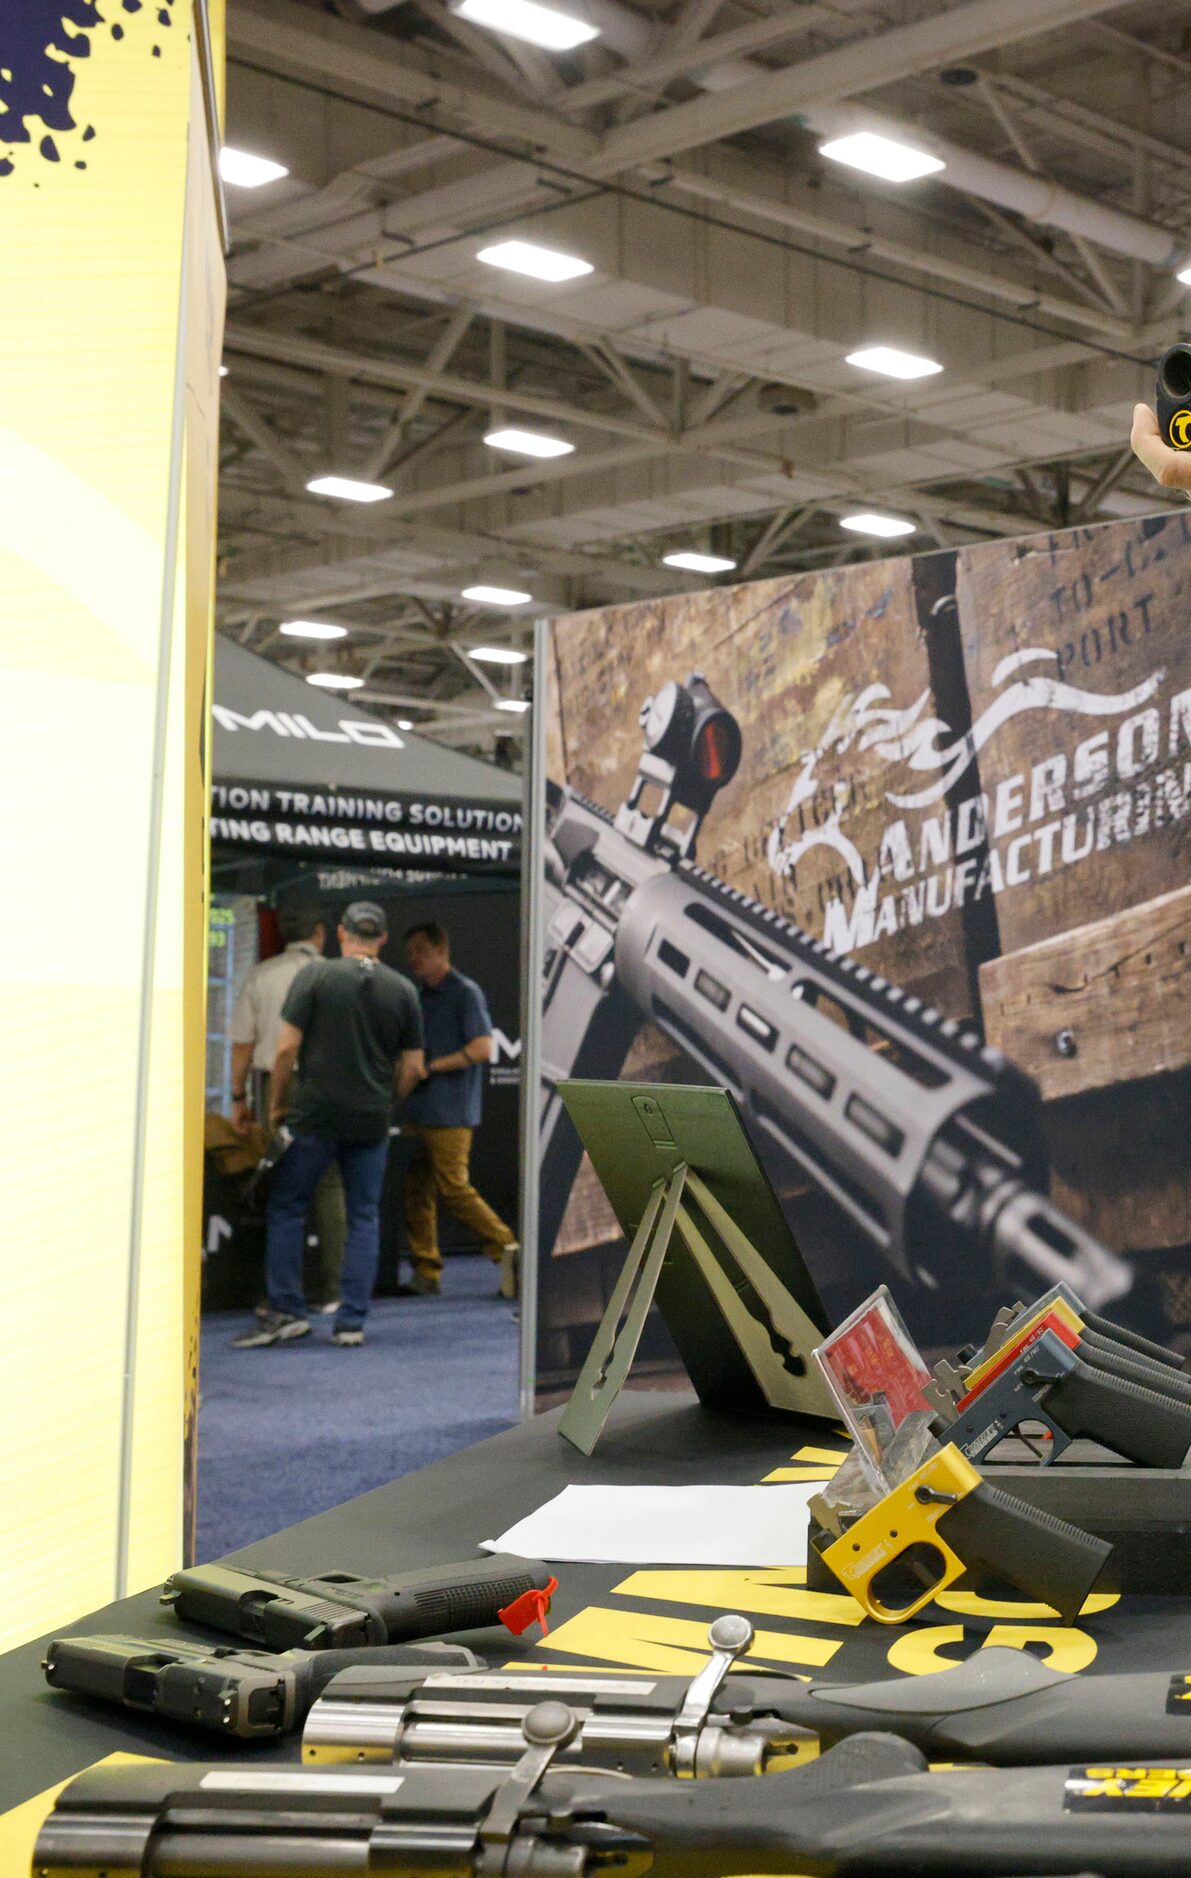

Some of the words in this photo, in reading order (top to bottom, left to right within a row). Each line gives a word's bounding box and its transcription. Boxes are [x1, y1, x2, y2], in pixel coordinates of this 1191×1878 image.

[211, 703, 405, 749] MILO
[275, 791, 402, 822] TRAINING
[274, 822, 365, 849] RANGE
[369, 830, 513, 861] EQUIPMENT
